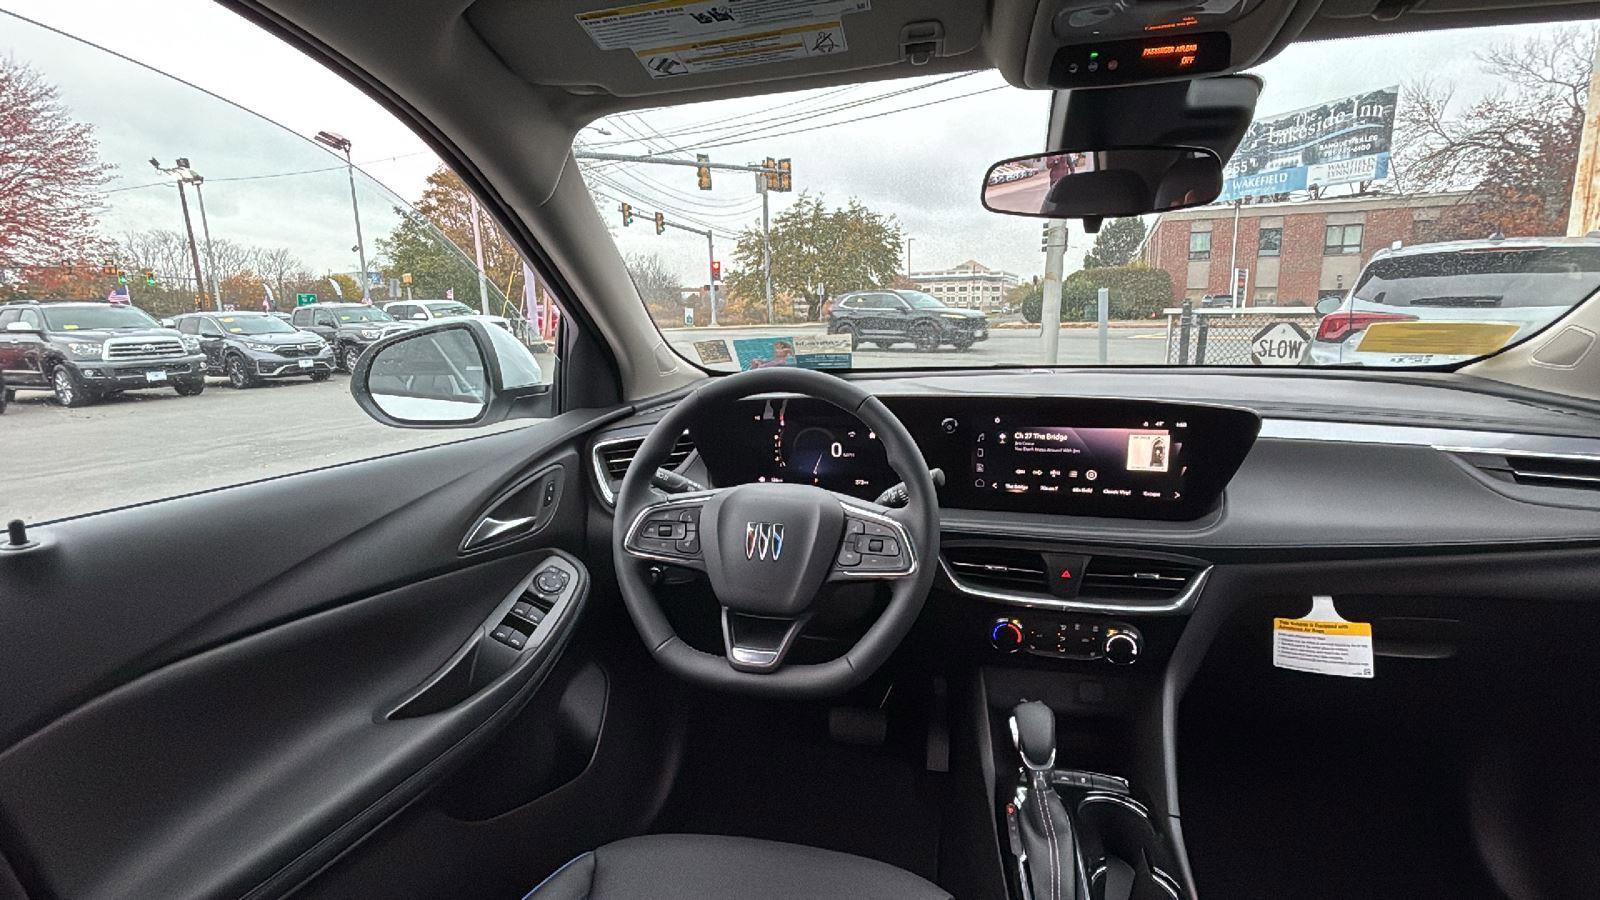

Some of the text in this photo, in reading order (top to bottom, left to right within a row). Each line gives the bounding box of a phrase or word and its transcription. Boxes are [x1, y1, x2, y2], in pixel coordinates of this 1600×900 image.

[1144, 44, 1198, 56] PASSENGER AIRBAG
[1181, 56, 1196, 64] OFF
[1268, 108, 1345, 144] Lakeside
[1352, 100, 1383, 118] Inn
[1294, 112, 1317, 128] The
[1232, 172, 1288, 190] WAKEFIELD
[1260, 340, 1302, 358] SLOW
[1046, 433, 1068, 442] Bridge
[831, 442, 842, 457] 0
